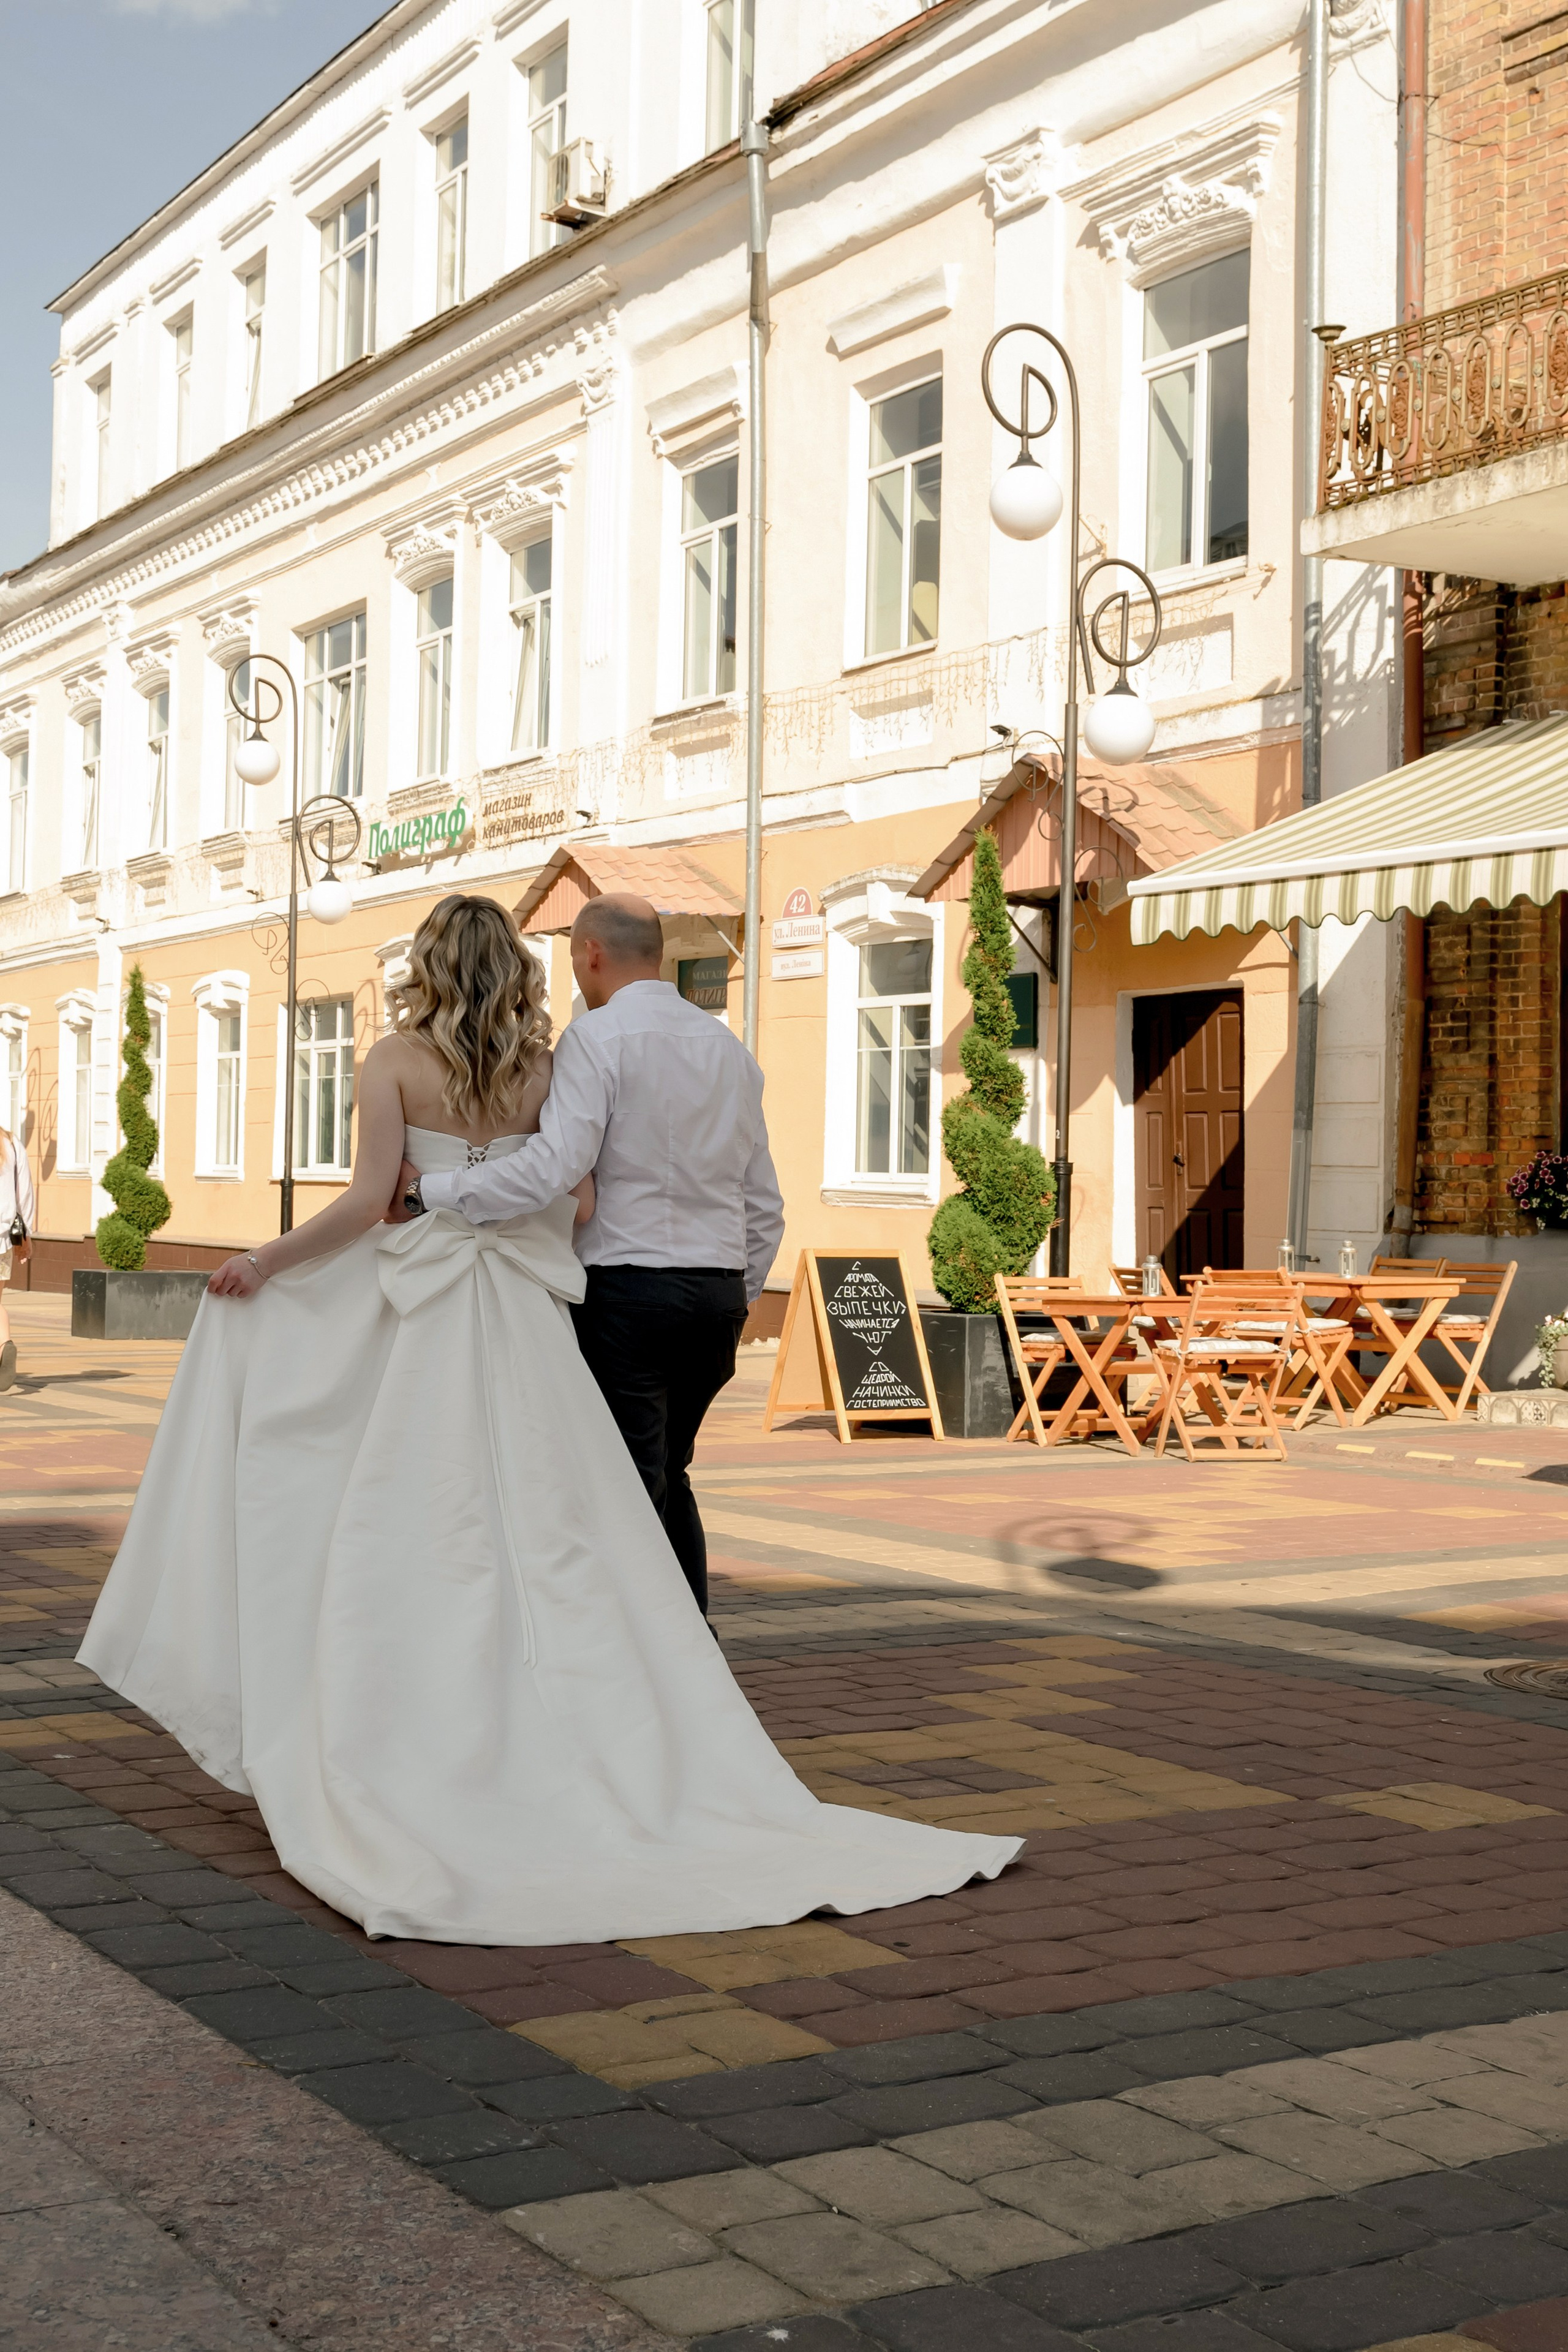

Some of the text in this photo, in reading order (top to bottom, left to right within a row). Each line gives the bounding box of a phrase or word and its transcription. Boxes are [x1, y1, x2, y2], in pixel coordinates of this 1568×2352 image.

[482, 793, 532, 817] магазин
[368, 797, 466, 858] Полиграф
[482, 810, 564, 839] канцтоваров
[790, 894, 806, 913] 42
[774, 922, 820, 943] ул. Ленина
[1056, 1129, 1060, 1139] 2
[852, 1261, 861, 1270] С
[843, 1273, 880, 1283] АРОМАТА
[834, 1283, 894, 1298] СВЕЖЕЙ
[826, 1301, 907, 1315] ВЫПЕЧКИ
[839, 1318, 900, 1329] НАЧИНАЕТСЯ
[852, 1331, 892, 1343] УЮТ
[869, 1362, 890, 1372] СО
[861, 1370, 902, 1385] ЩЕДРОЙ
[852, 1385, 916, 1398] НАЧИНКИ
[846, 1398, 926, 1408] ГОСТЕПРИИМСТВО
